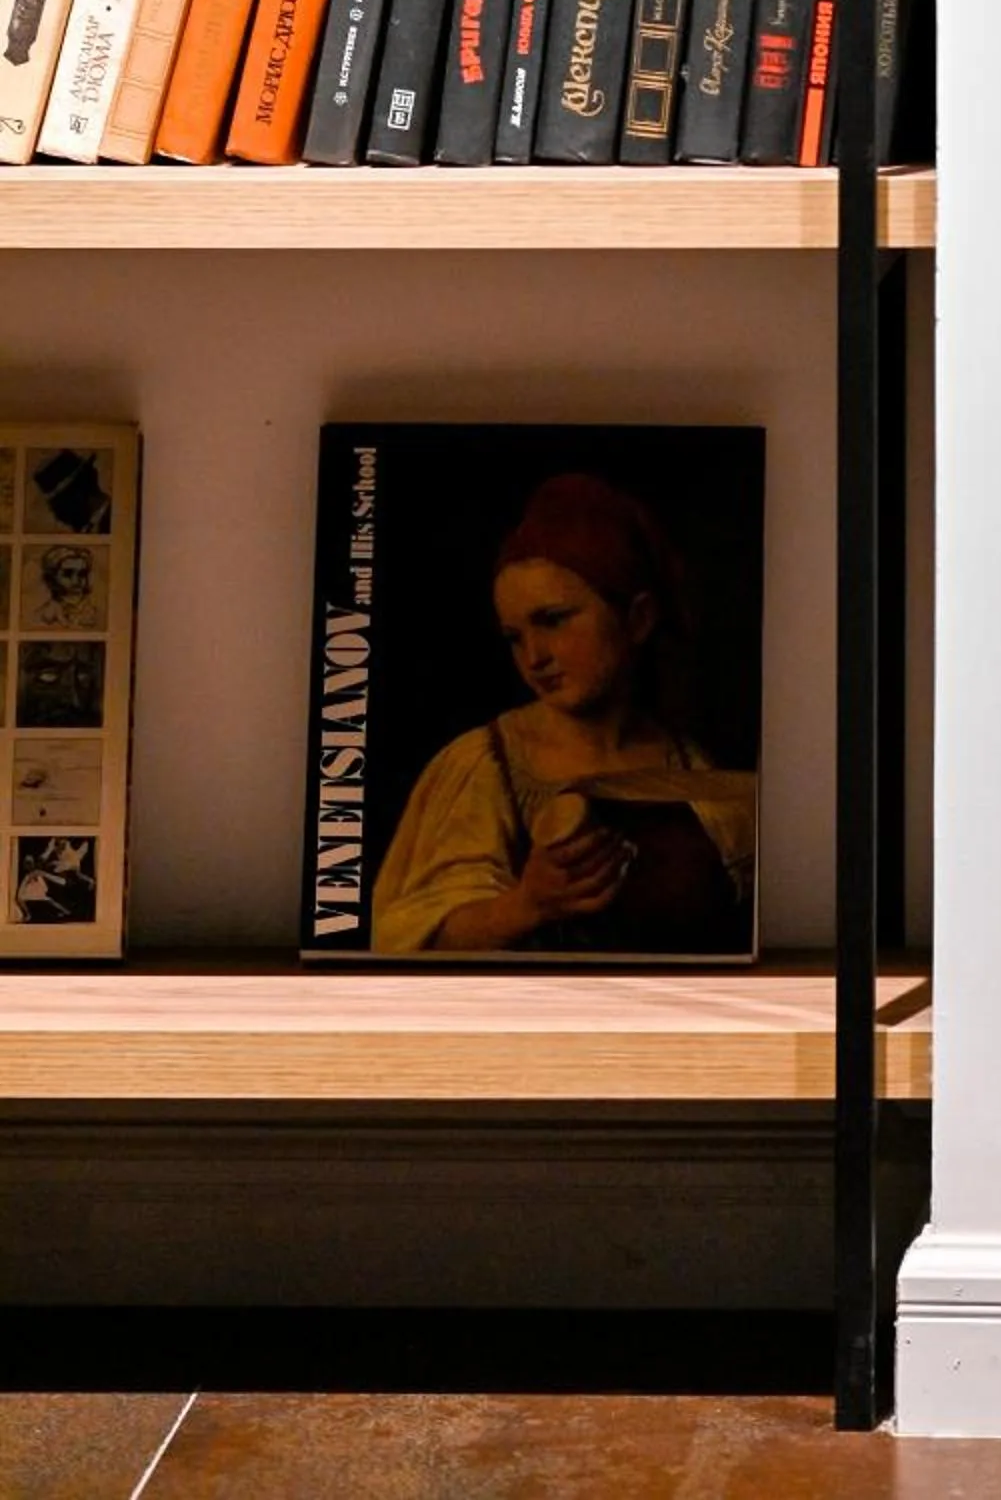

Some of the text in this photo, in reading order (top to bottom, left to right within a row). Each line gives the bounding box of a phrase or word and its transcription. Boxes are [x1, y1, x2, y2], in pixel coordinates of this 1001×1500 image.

[83, 32, 114, 104] ДЮМА
[808, 1, 834, 86] ЯПОНИЯ
[256, 47, 286, 126] МОРИС
[352, 447, 377, 519] School
[350, 565, 373, 606] and
[313, 602, 372, 937] VENETSIANOV
